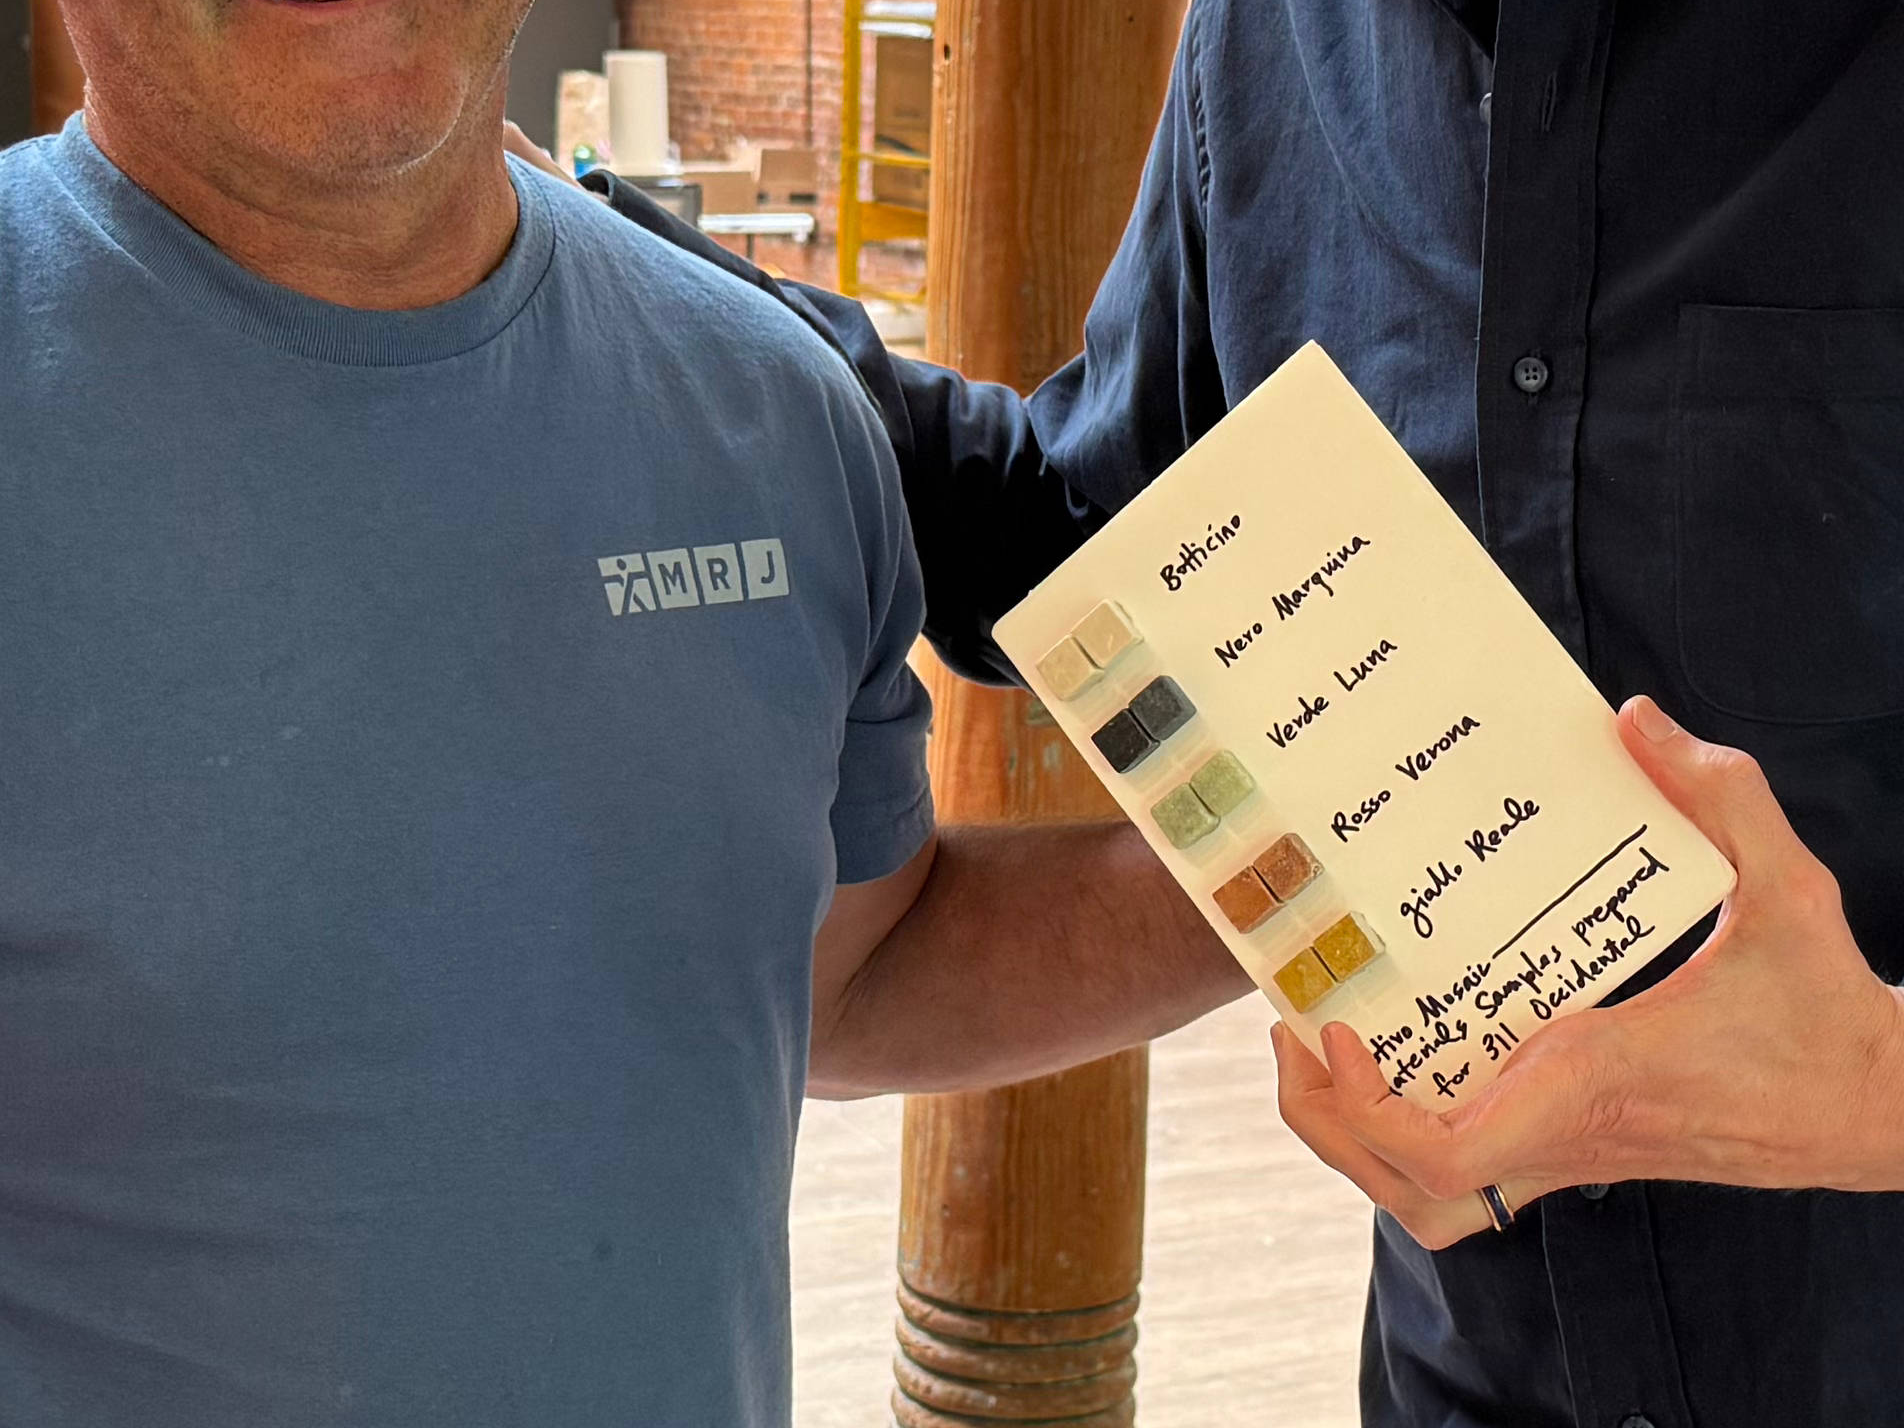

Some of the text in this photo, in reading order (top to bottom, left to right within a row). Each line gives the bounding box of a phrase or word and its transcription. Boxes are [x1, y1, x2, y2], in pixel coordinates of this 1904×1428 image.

[656, 549, 777, 597] MRJ
[1159, 514, 1241, 592] Botticino
[1214, 536, 1371, 668] Nero Marquina
[1266, 639, 1398, 749] Verde Luna
[1330, 715, 1481, 843] Rosso Verona
[1464, 797, 1540, 863] Reale
[1474, 945, 1562, 1019] Samples
[1571, 846, 1670, 947] prepared
[1415, 962, 1491, 1028] Mosaic
[1432, 915, 1656, 1099] for 311 Occidental
